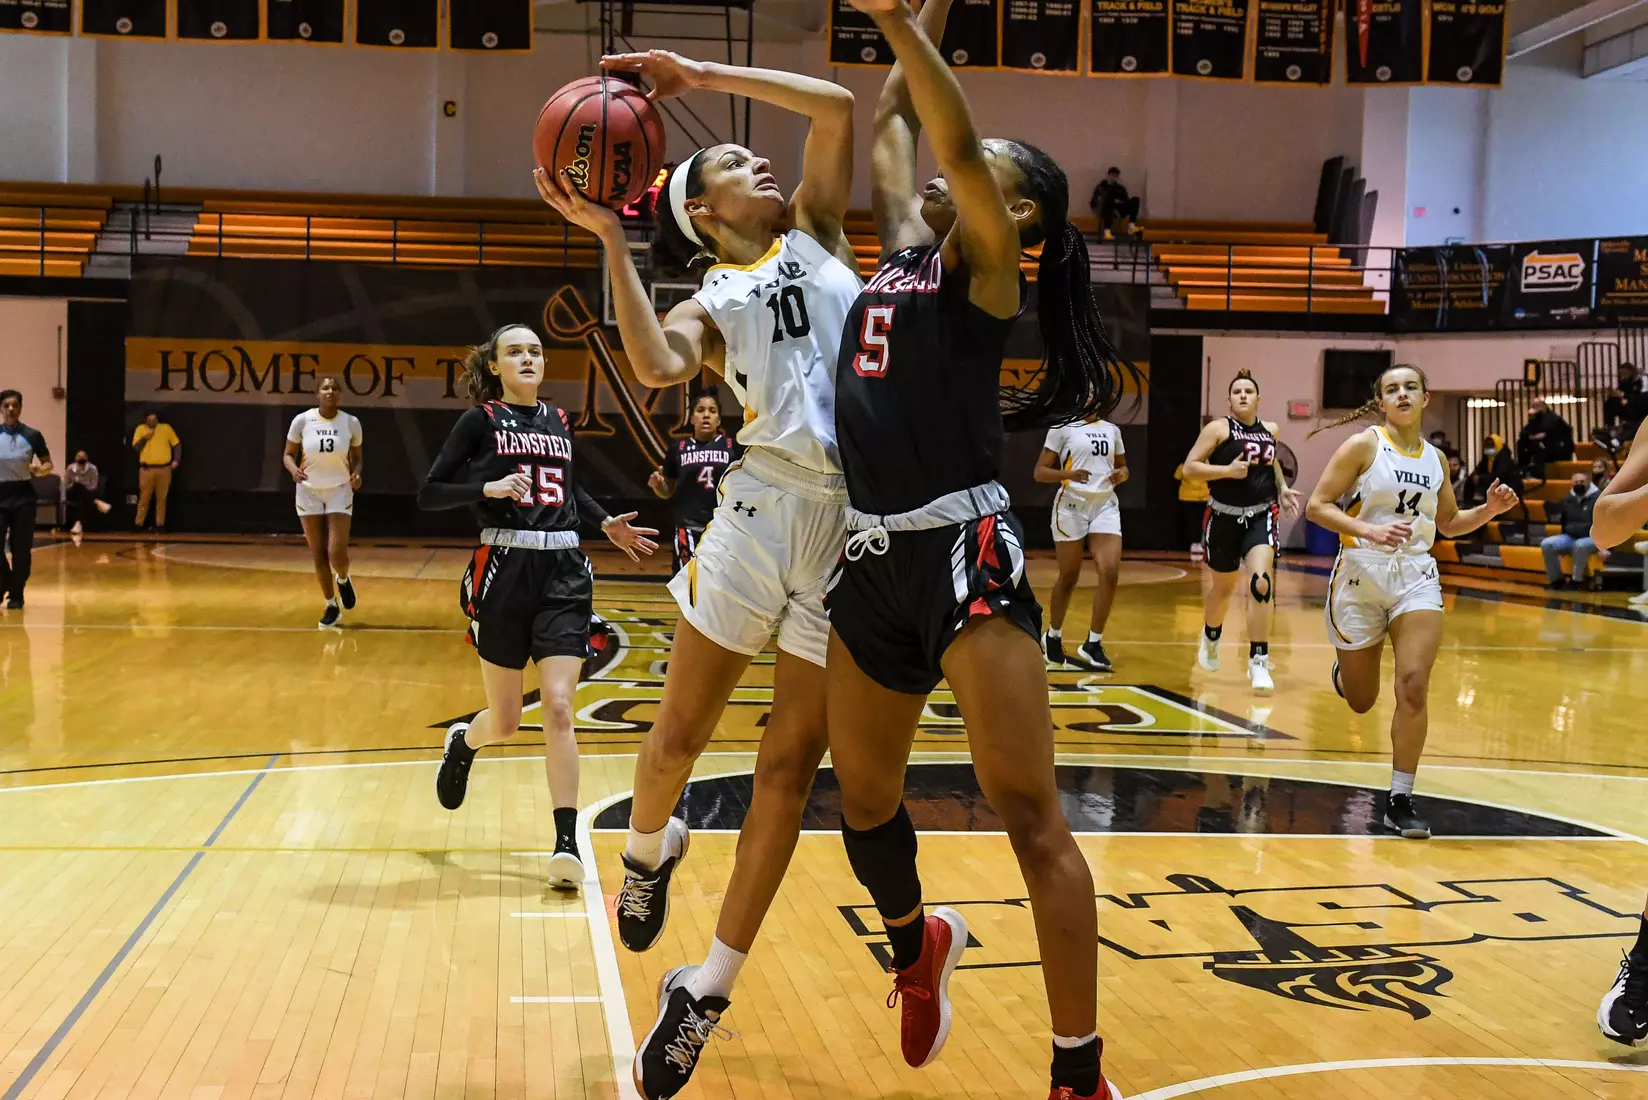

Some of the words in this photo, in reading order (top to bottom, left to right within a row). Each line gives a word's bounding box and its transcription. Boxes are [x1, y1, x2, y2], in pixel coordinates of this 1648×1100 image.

[565, 123, 597, 190] ilson
[608, 141, 632, 201] NCAA
[1524, 263, 1580, 280] PSAC
[766, 284, 811, 343] 10
[852, 304, 895, 379] 5
[155, 346, 322, 395] HOME
[342, 353, 417, 398] OF
[319, 438, 334, 453] 13
[494, 429, 573, 463] MANSFIELD
[680, 449, 730, 467] MANSFIELD
[1091, 440, 1109, 457] 30
[517, 462, 565, 508] 15
[696, 465, 716, 490] 4
[1394, 469, 1431, 490] VILLE
[1394, 489, 1423, 516] 14
